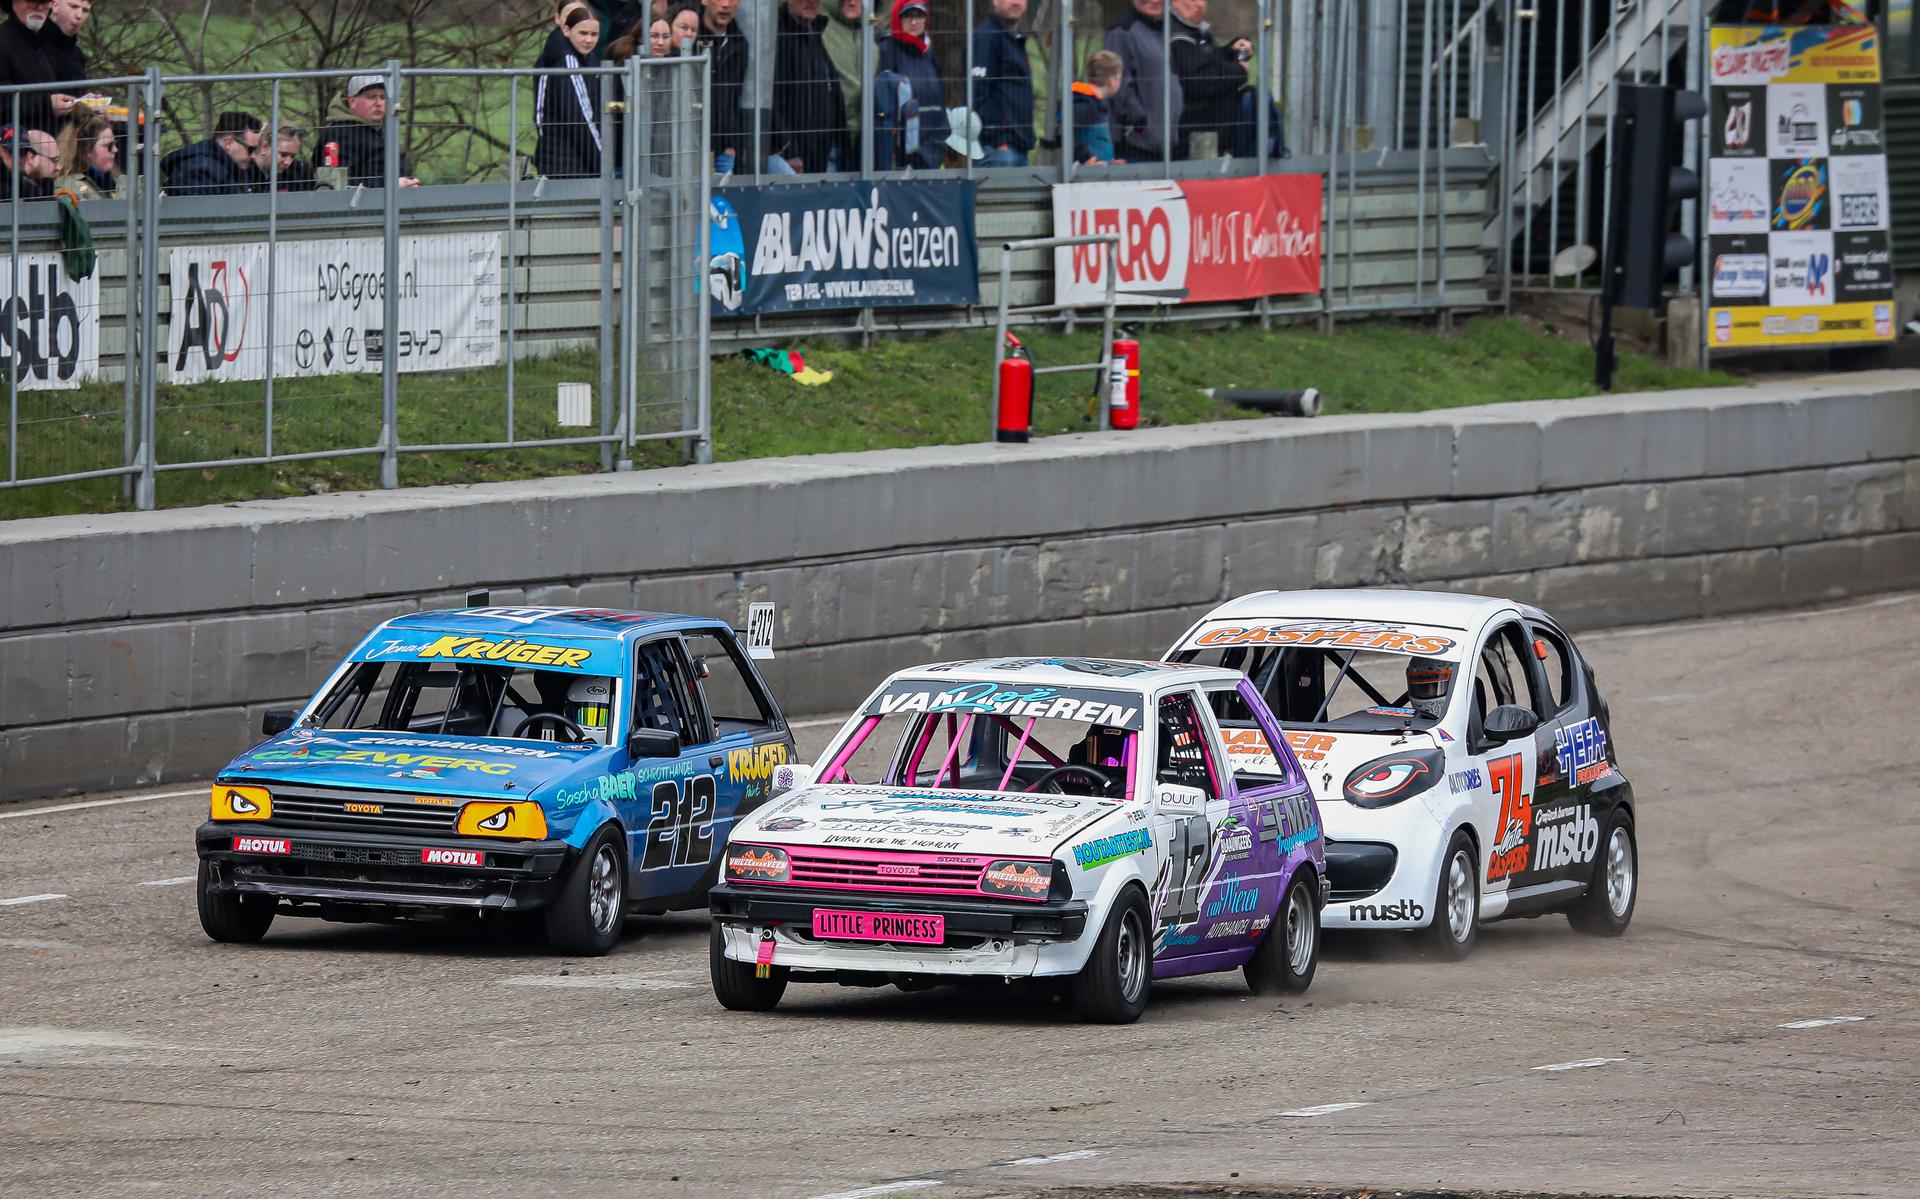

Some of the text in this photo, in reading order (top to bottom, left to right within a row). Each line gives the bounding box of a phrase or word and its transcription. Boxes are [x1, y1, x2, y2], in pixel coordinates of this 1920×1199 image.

[891, 211, 959, 268] reizen
[749, 608, 774, 647] #212
[365, 635, 592, 669] Jonas KRÜGER
[1196, 627, 1457, 654] CASPERS
[347, 737, 561, 759] ZURHAUSEN
[557, 772, 637, 809] Sascha BAER
[1161, 791, 1198, 805] puur
[1487, 752, 1533, 846] 74
[345, 803, 382, 814] TOYOTA
[641, 774, 716, 872] 212
[237, 838, 287, 853] MOTUL
[911, 839, 963, 850] MOMENT
[1534, 804, 1599, 871] mustb
[426, 850, 481, 864] MOTUL
[937, 855, 978, 864] STARLET
[880, 866, 916, 875] TOYOTA
[1350, 899, 1424, 921] mustb
[820, 914, 936, 938] LITTLE PRINCESS
